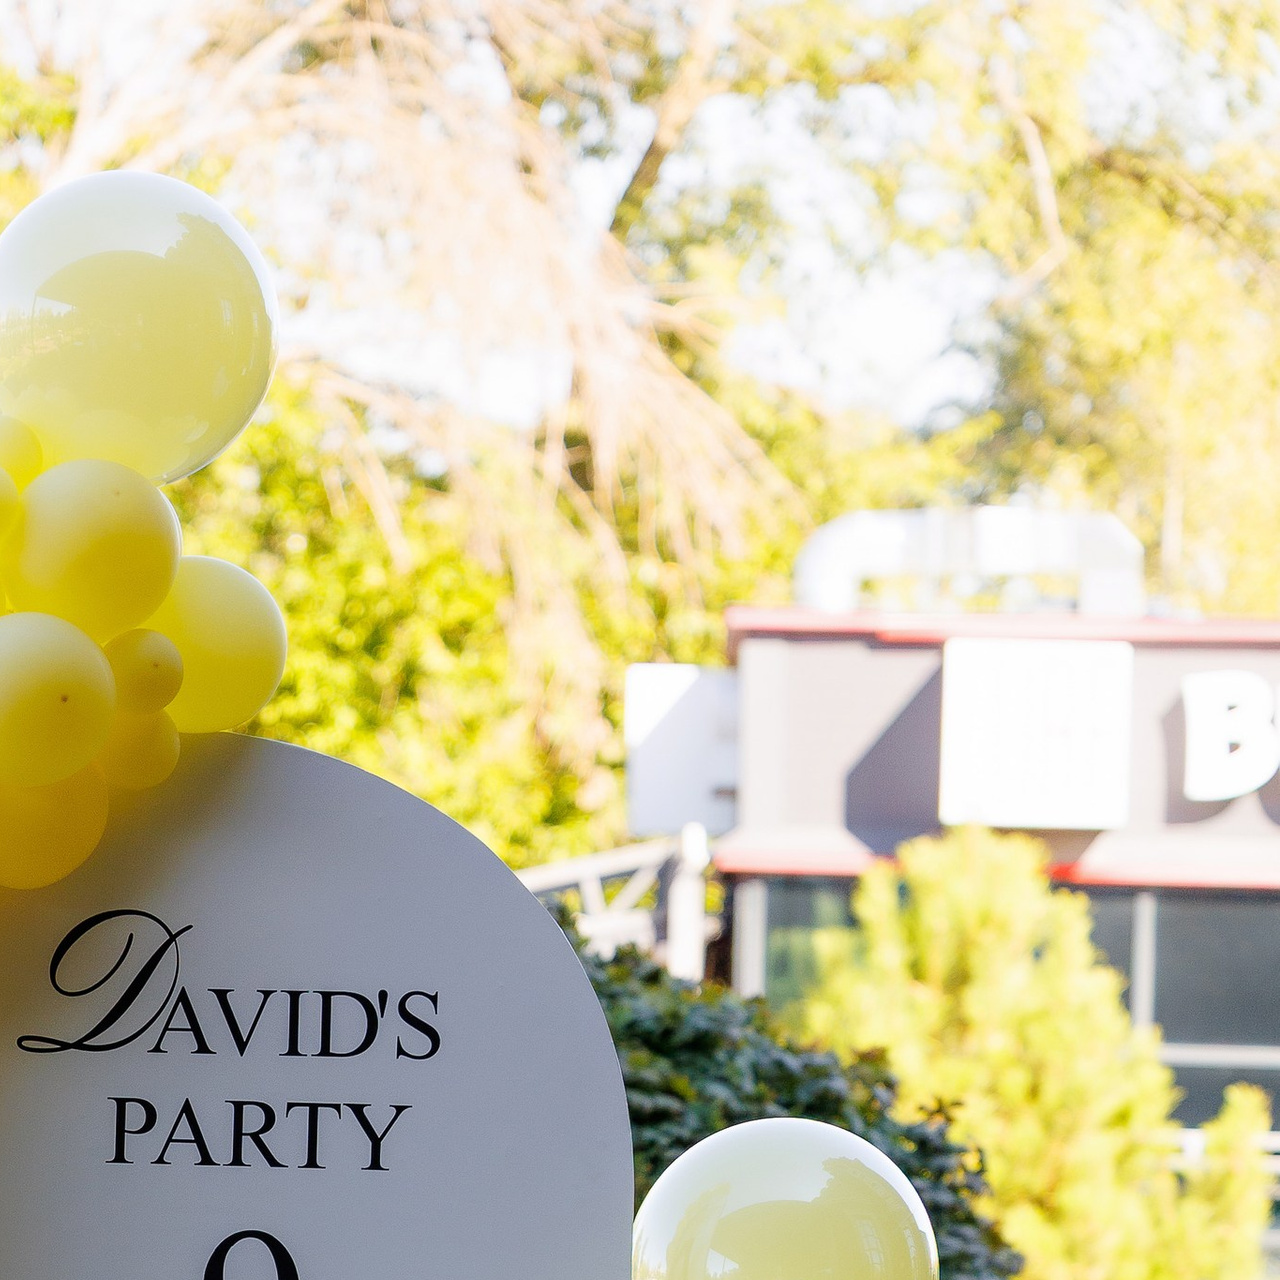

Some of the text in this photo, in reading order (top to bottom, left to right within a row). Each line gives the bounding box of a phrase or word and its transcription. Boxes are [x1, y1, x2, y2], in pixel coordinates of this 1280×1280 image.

[1181, 668, 1280, 801] B
[16, 908, 441, 1060] DAVID'S
[105, 1096, 413, 1171] PARTY
